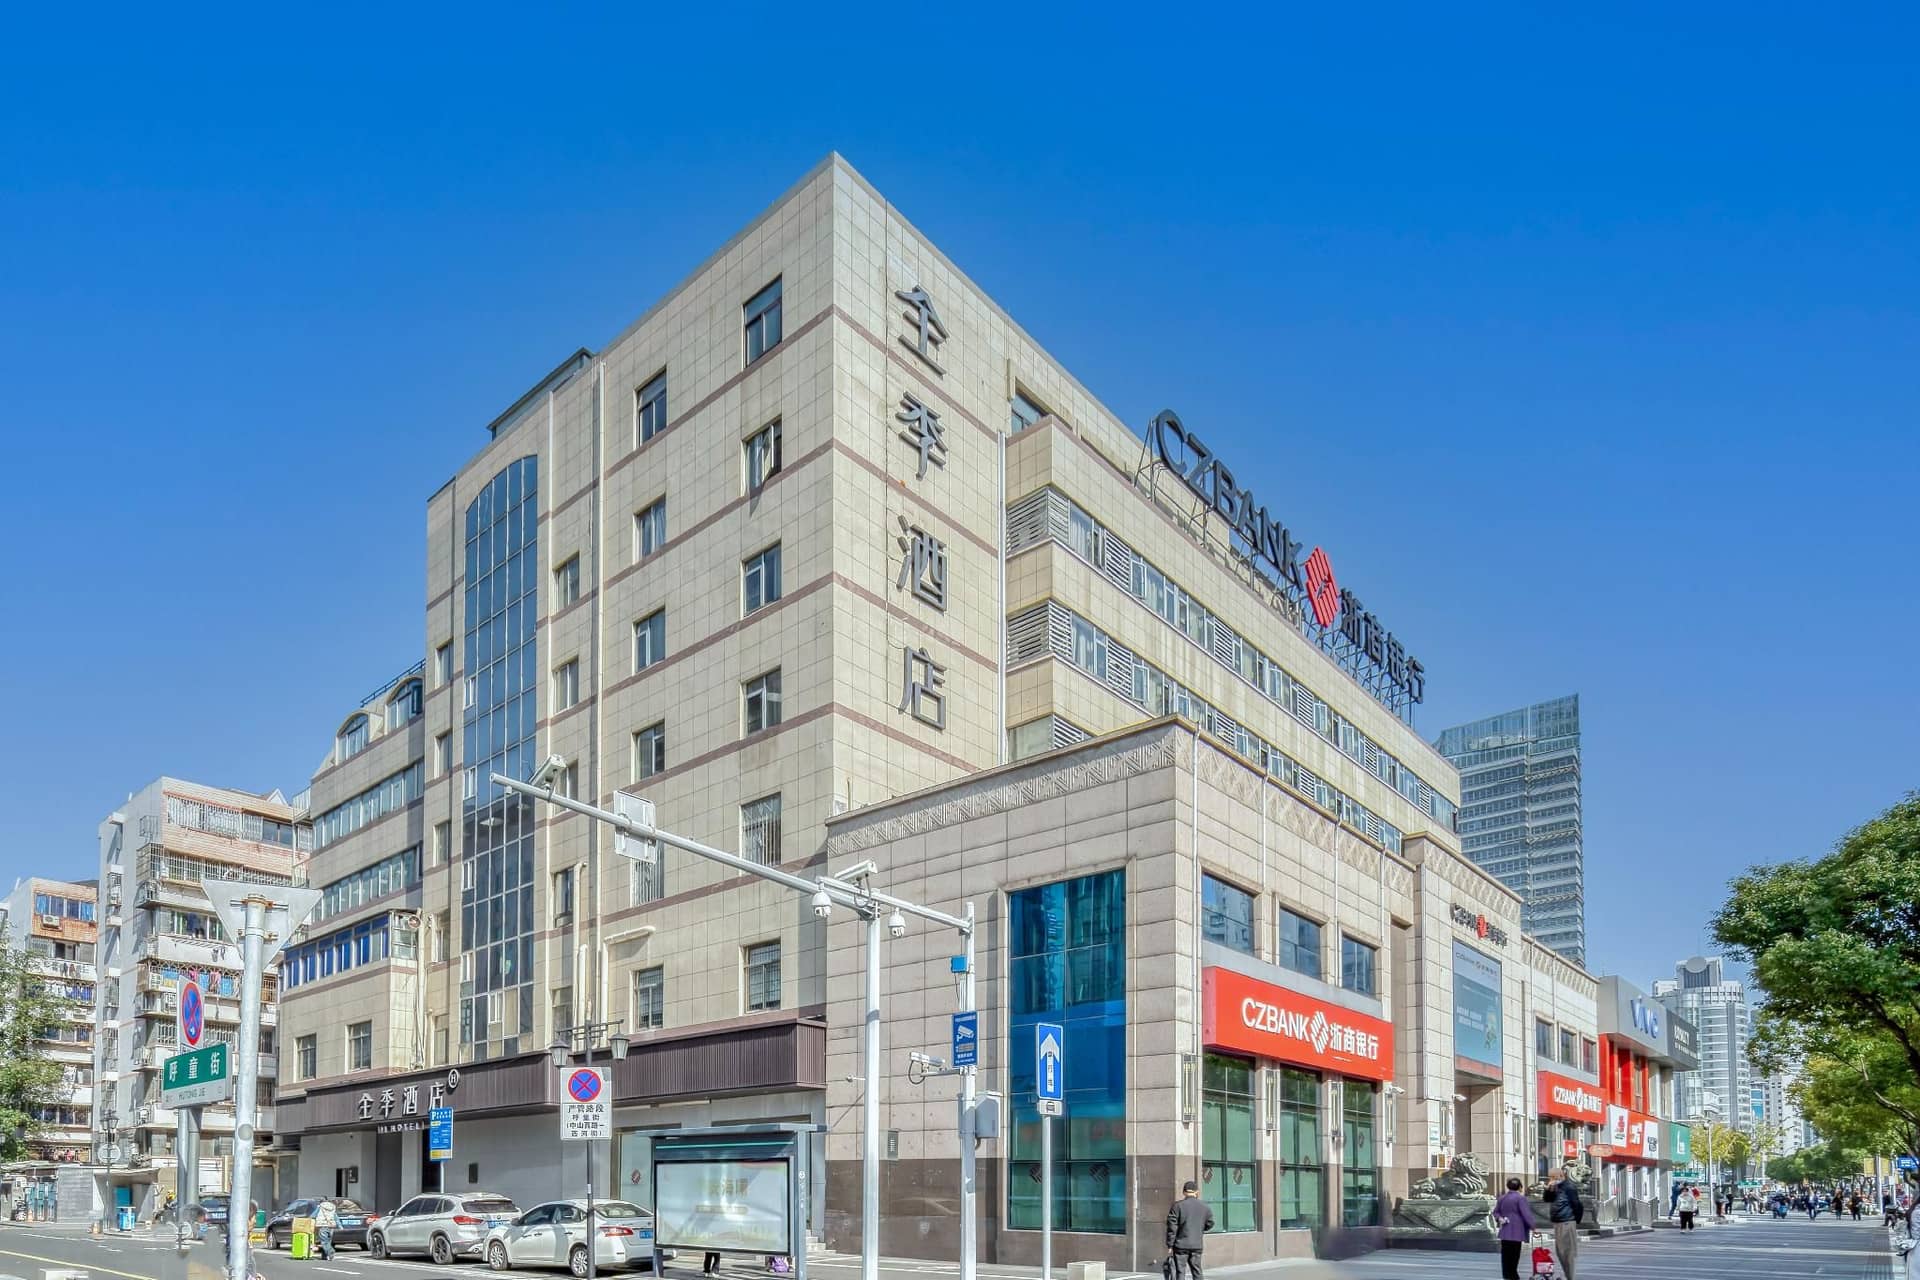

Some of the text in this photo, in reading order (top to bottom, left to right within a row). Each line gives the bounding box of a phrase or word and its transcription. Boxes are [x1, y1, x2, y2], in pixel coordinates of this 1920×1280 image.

[894, 284, 949, 735] 全季酒店
[1154, 408, 1304, 592] CZBANK
[1241, 997, 1380, 1061] CZBANK 浙商银行
[358, 1082, 445, 1120] 全季酒店
